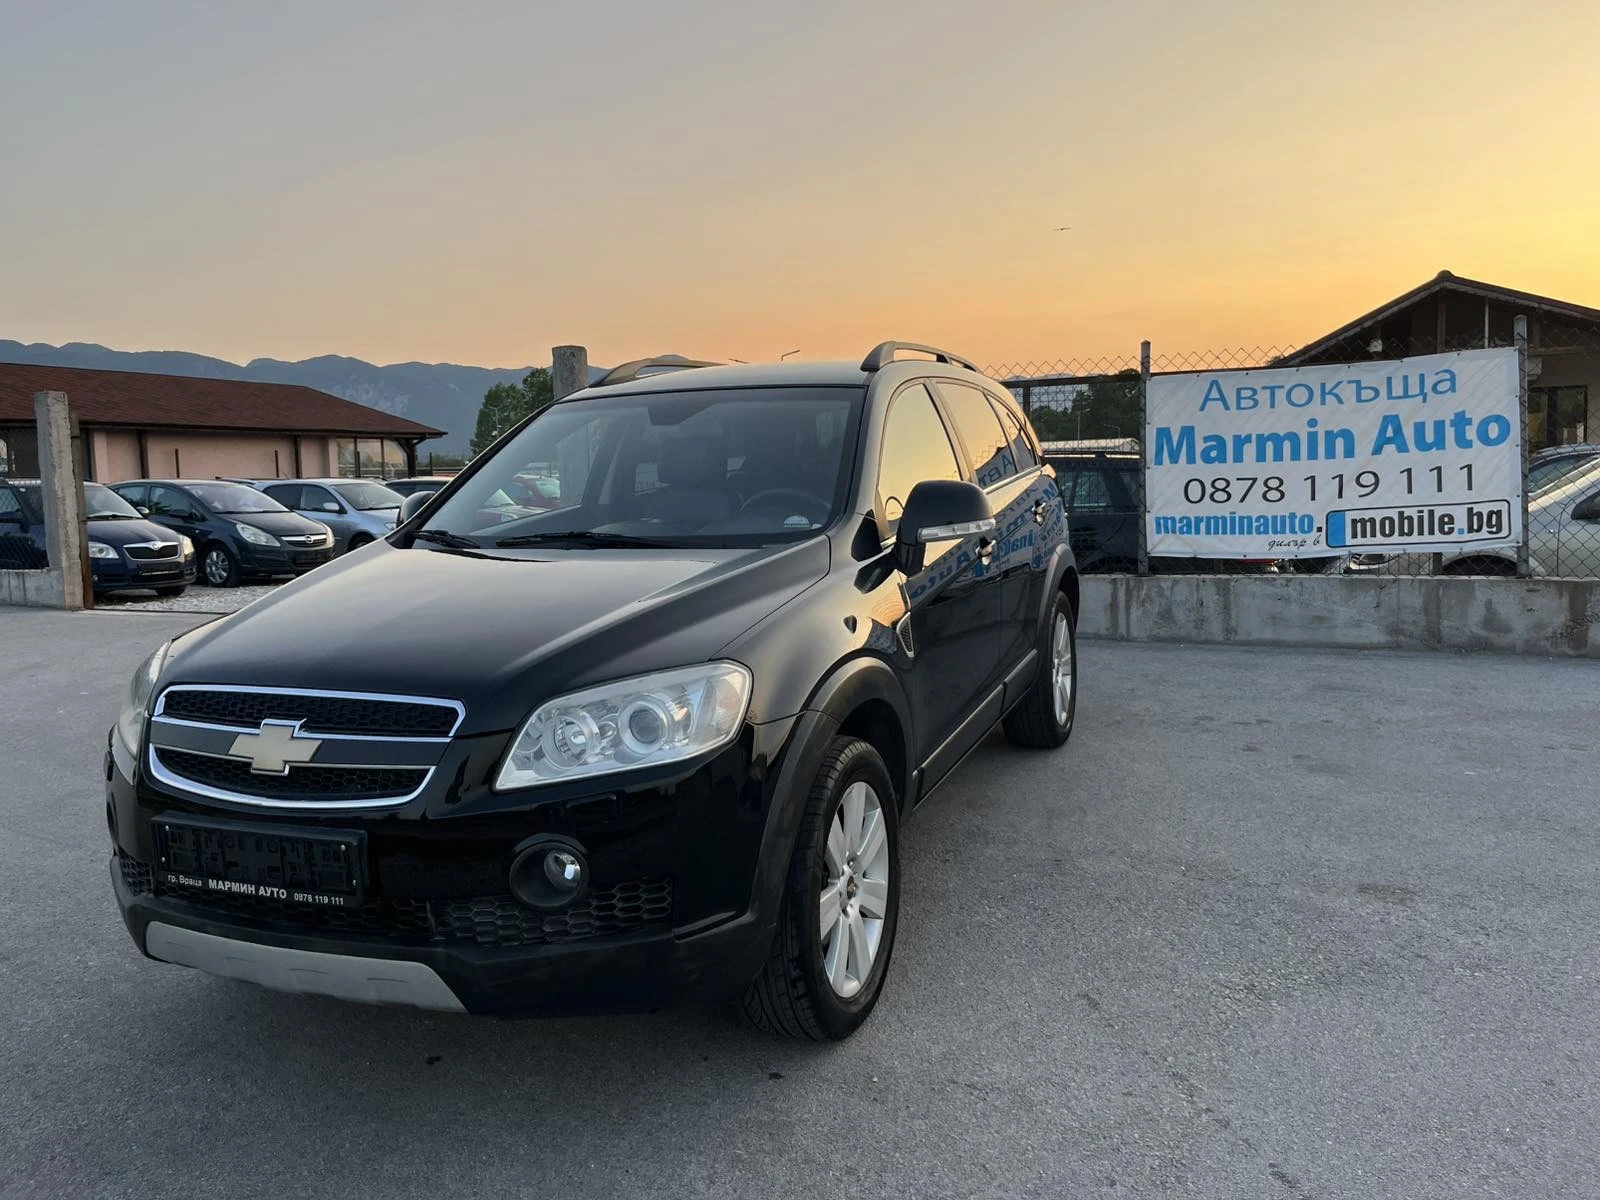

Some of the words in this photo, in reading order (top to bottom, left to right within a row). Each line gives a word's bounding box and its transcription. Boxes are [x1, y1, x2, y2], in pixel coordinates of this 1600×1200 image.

[1199, 368, 1457, 412] Автокъща
[1154, 417, 1355, 466] Marmin
[1371, 409, 1511, 456] Auto
[1183, 476, 1286, 504] 0878
[1303, 470, 1380, 502] 119
[1400, 463, 1473, 495] 111
[1350, 506, 1503, 540] mobile.bg
[208, 879, 256, 894] МАРМИН
[258, 886, 287, 899] АУТО
[293, 892, 313, 902] 0878
[315, 895, 329, 904] 119
[331, 896, 344, 905] 111
